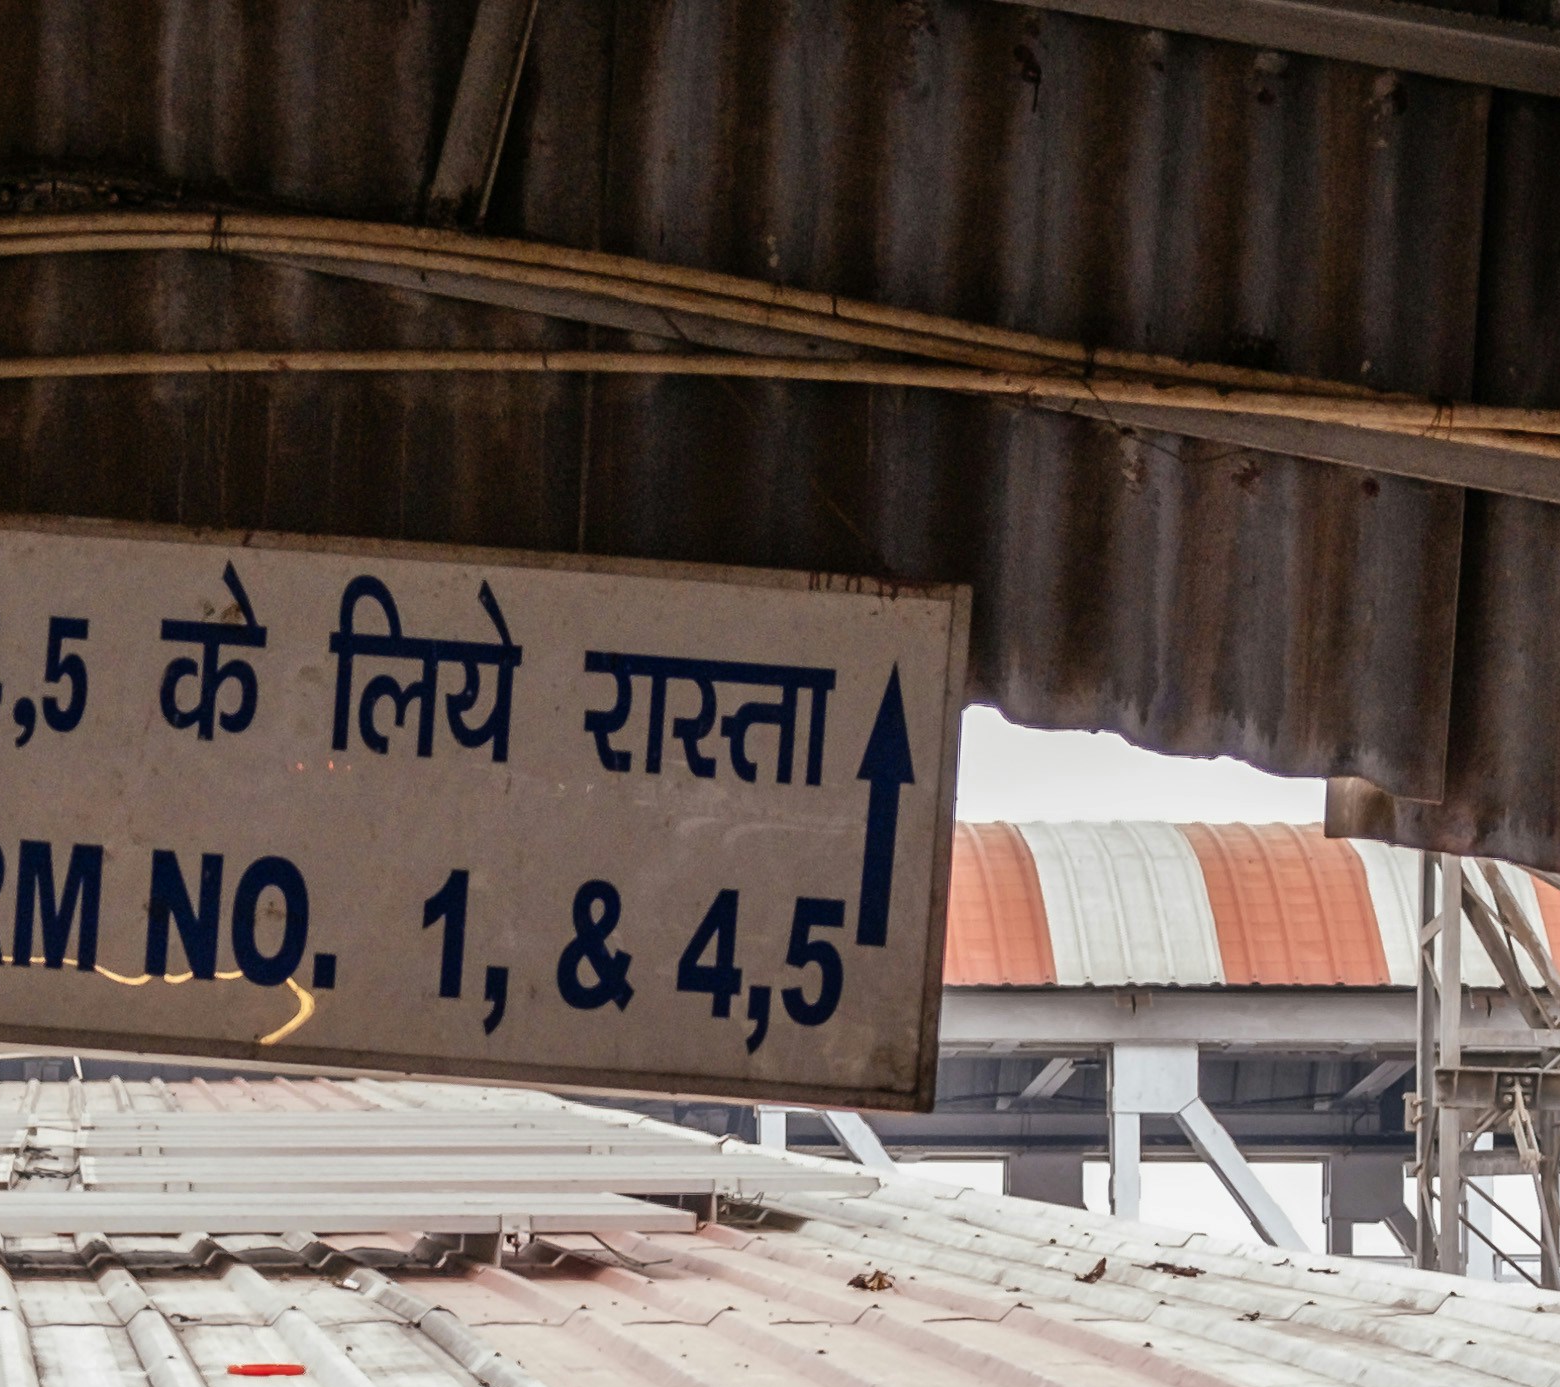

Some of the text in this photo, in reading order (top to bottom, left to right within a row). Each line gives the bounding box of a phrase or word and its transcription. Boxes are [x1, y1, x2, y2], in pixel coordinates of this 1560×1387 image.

[159, 559, 268, 741] के
[328, 574, 523, 763] लिये
[584, 650, 837, 787] रास्ता
[145, 848, 338, 988] NO.
[422, 868, 510, 1036] 1,
[556, 878, 635, 1012] &
[676, 888, 847, 1055] 4,5
